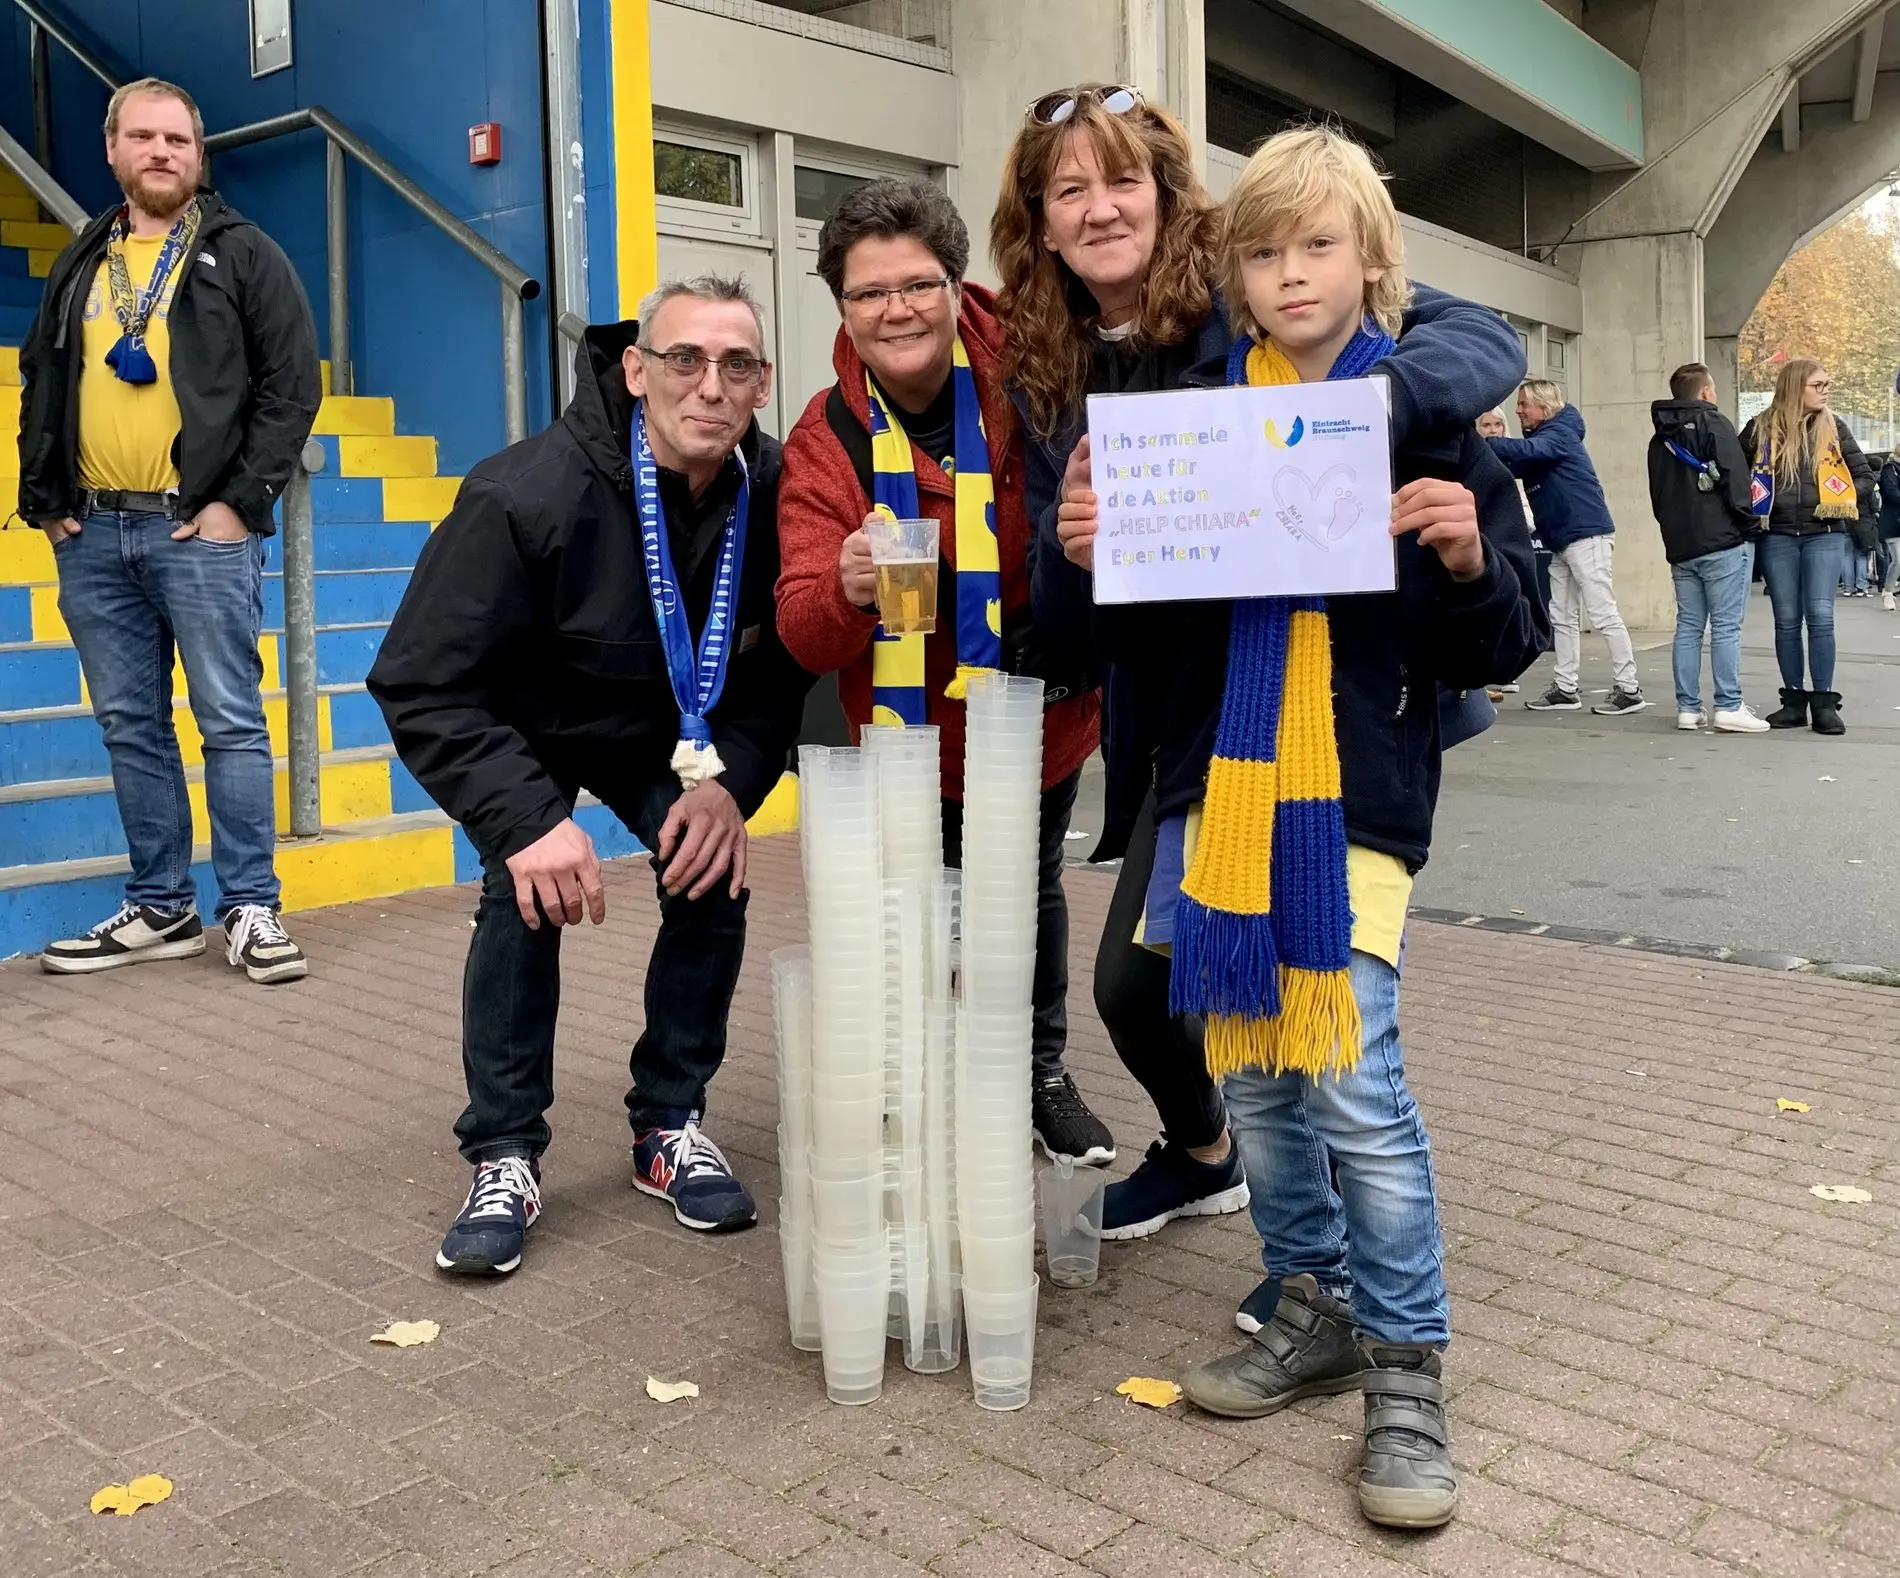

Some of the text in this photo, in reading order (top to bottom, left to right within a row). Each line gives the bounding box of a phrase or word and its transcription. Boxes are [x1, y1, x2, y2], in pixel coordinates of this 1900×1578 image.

[1312, 419, 1351, 428] Eintracht
[1312, 424, 1370, 434] Braunschweig
[1103, 426, 1228, 452] Ich sammele
[1106, 458, 1197, 480] heute für
[1107, 486, 1209, 508] die Aktion
[1111, 545, 1221, 566] Euer Henry
